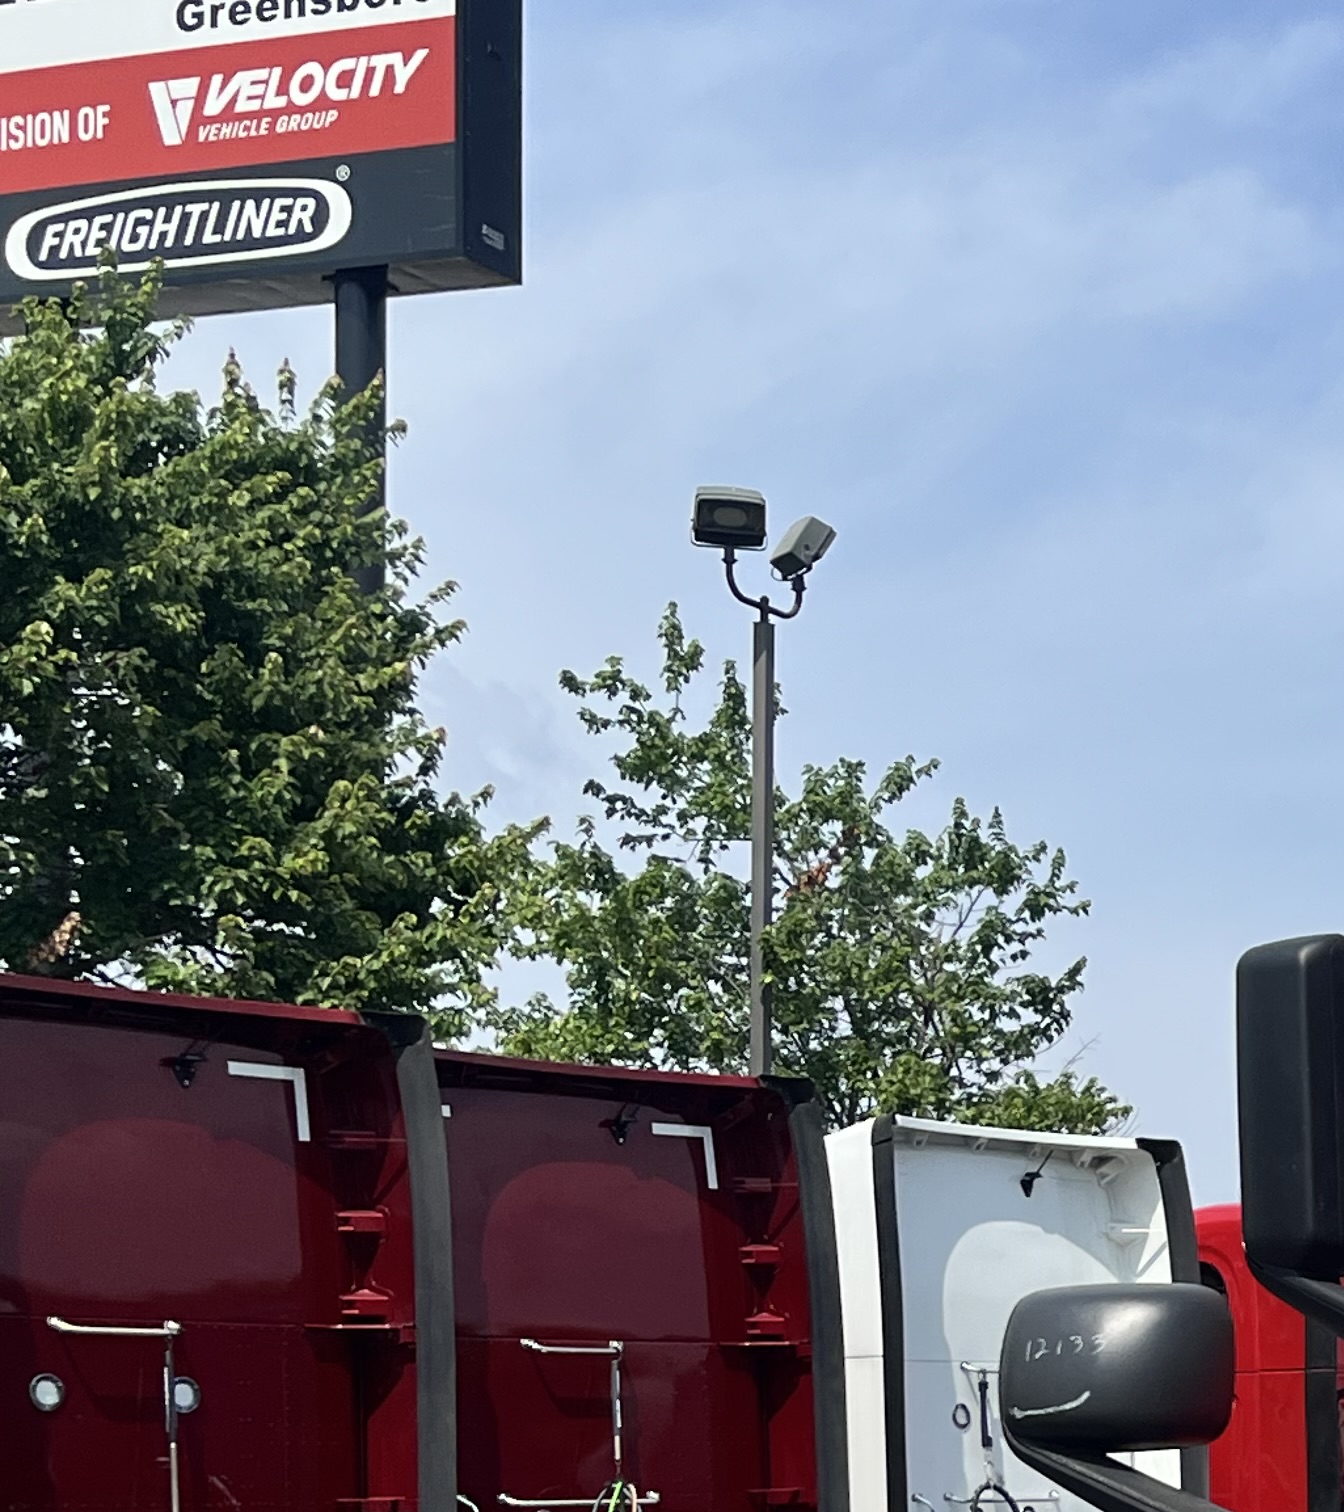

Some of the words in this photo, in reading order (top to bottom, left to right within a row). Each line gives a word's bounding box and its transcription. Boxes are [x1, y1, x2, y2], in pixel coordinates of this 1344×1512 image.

[202, 48, 429, 117] VELOCITY
[77, 104, 111, 142] OF
[198, 117, 272, 142] VEHICLE
[275, 109, 339, 134] GROUP
[38, 197, 316, 262] FREIGHTLINER
